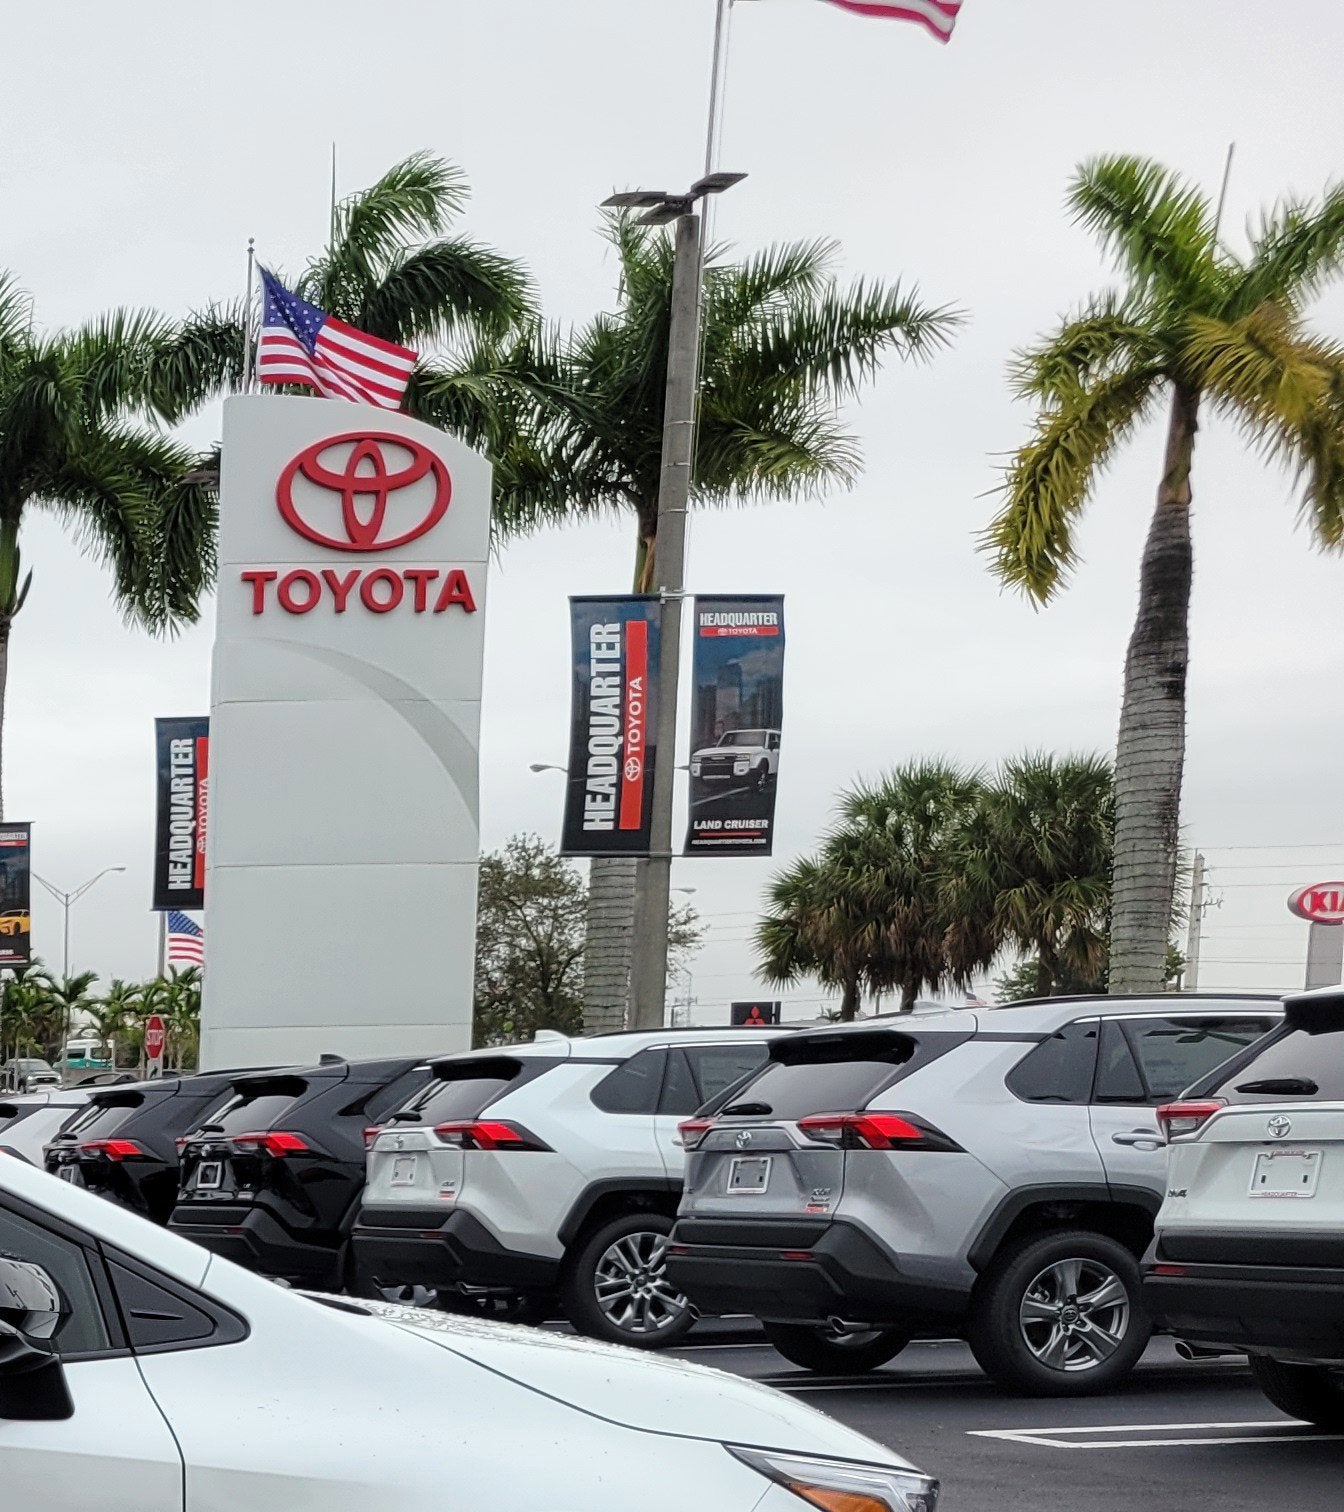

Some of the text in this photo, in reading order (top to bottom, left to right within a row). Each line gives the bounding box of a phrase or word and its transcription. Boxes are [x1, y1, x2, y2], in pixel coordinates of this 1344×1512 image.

[241, 567, 478, 615] TOYOTA
[699, 612, 778, 627] HEADQUARTER
[728, 627, 758, 635] TOYOTA
[582, 622, 624, 831] HEADQUARTER
[627, 676, 643, 755] TOYOTA
[168, 738, 197, 890] HEADQUARTER
[198, 777, 209, 835] TOYOTA
[693, 819, 769, 830] LAND CRUISER
[146, 1029, 163, 1046] STOP
